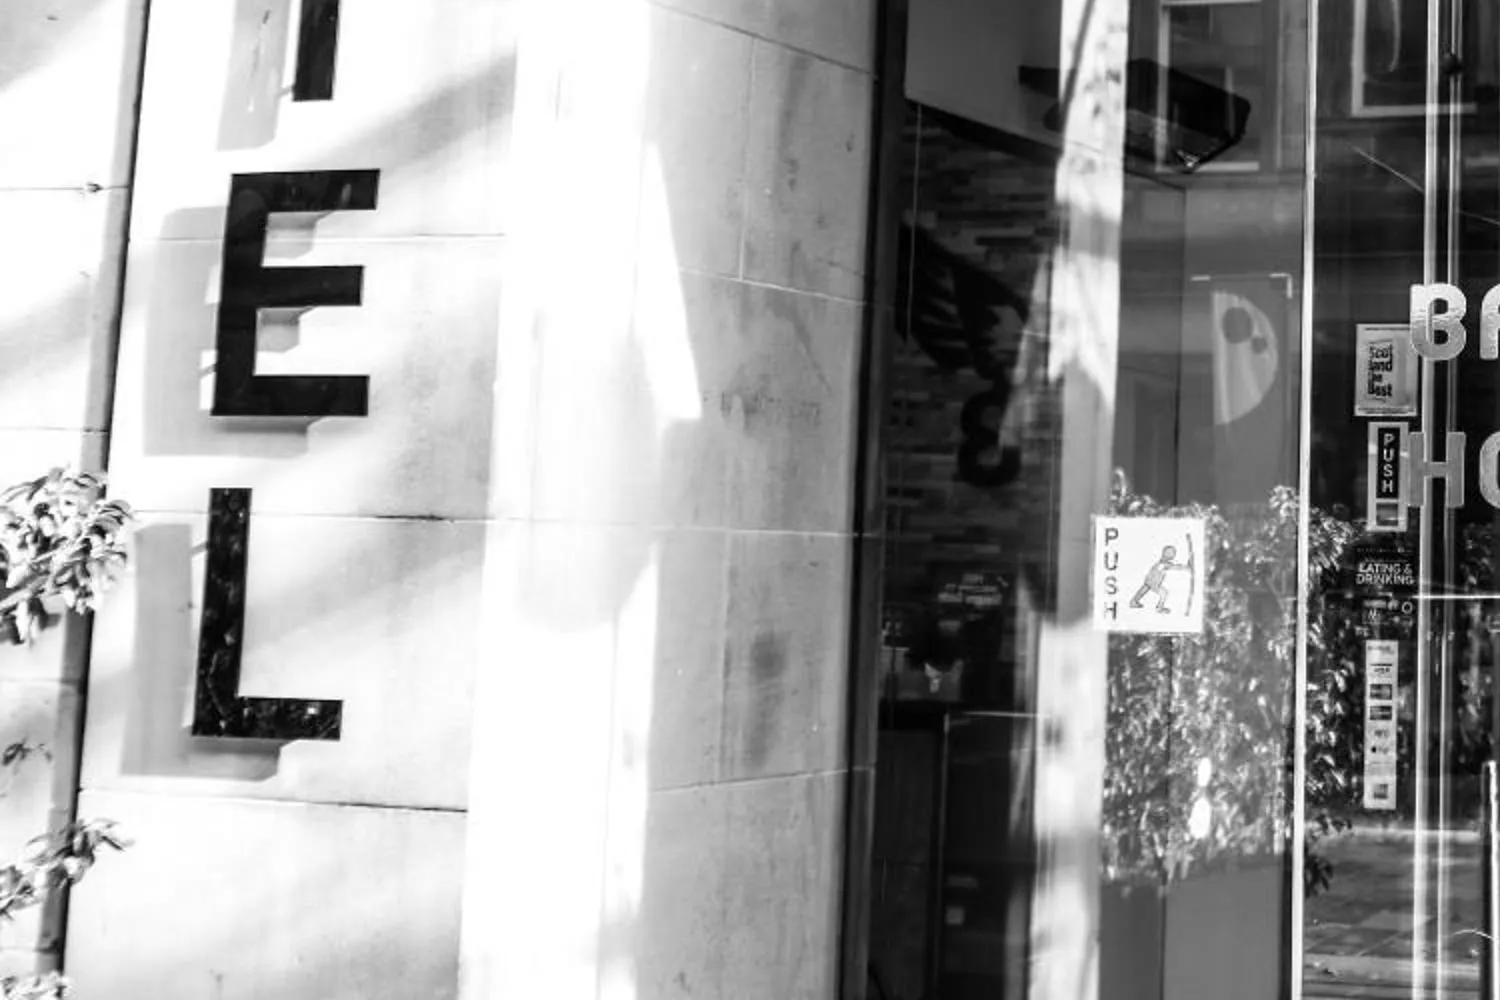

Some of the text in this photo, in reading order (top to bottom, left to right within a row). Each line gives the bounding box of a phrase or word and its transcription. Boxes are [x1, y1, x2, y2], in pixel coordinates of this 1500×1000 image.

[1382, 433, 1395, 493] PUSH
[1104, 527, 1119, 620] PUSH
[1355, 573, 1414, 585] DRINKING
